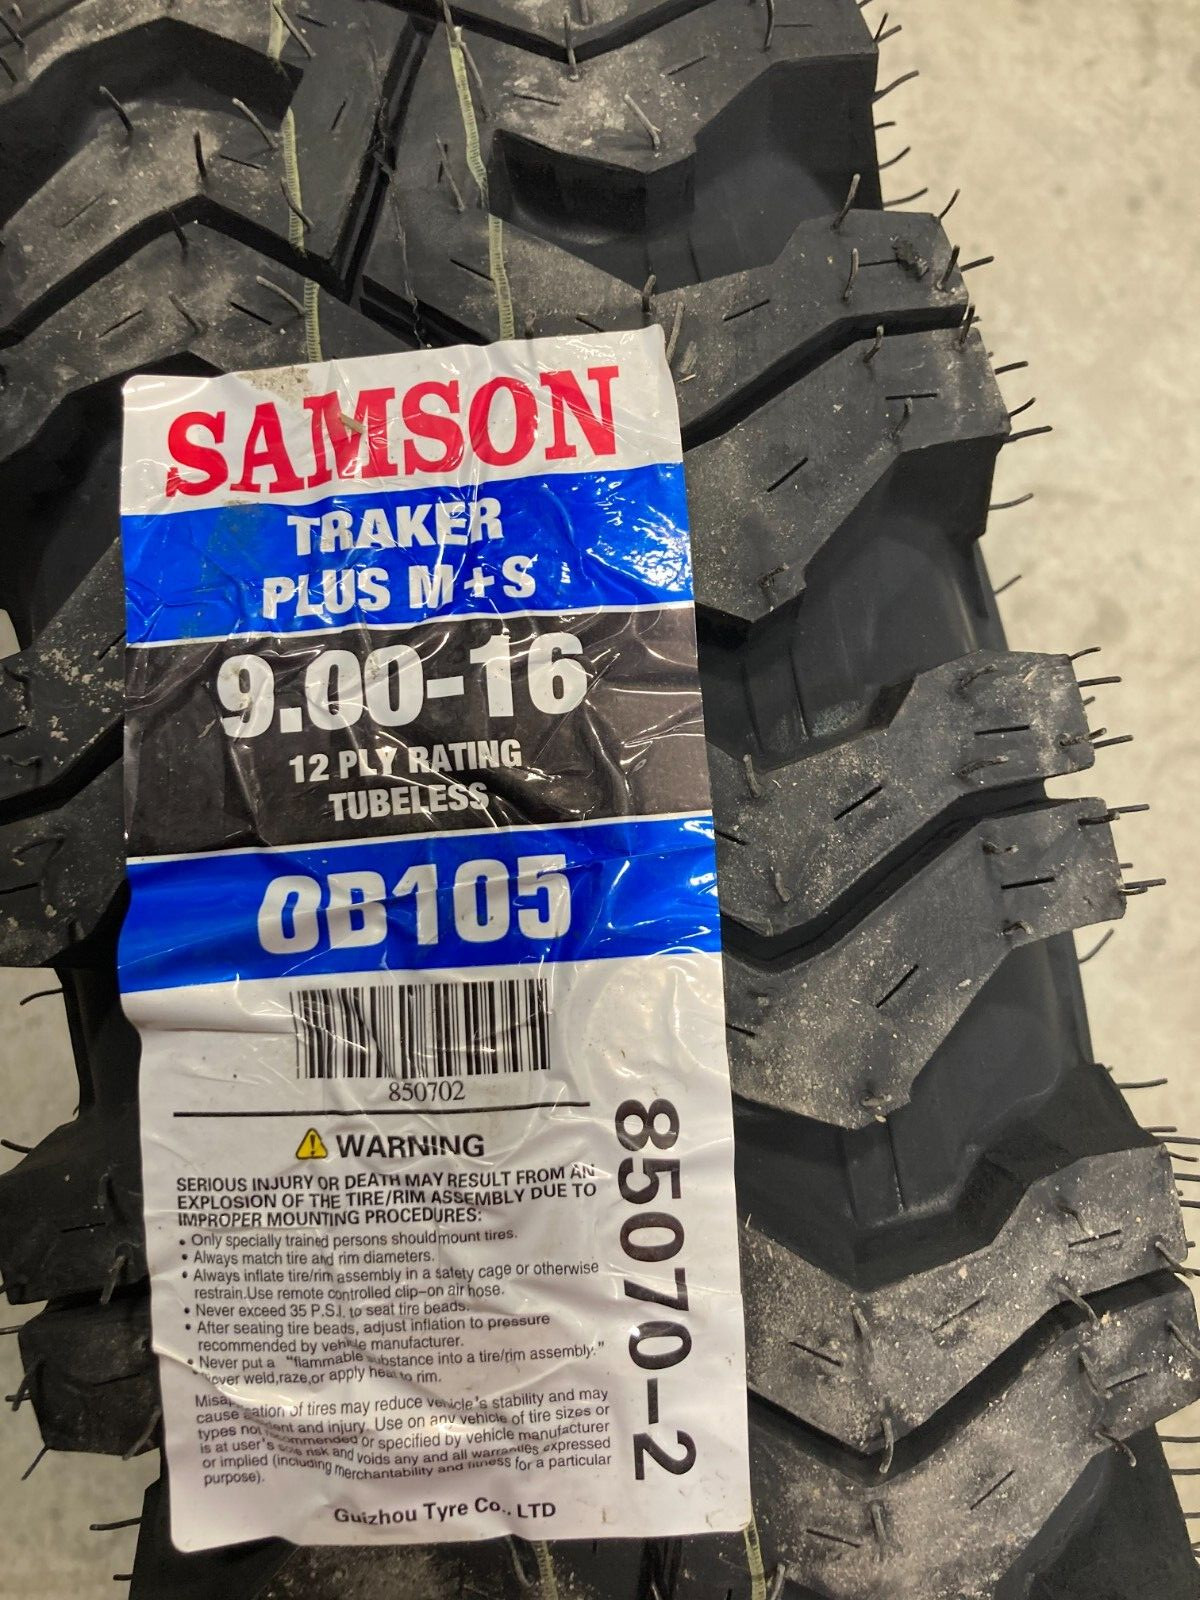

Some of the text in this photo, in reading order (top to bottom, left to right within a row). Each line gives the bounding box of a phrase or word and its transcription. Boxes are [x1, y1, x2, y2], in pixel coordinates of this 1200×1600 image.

[165, 366, 619, 497] SAMSON
[287, 497, 503, 556] TRAKER
[263, 564, 391, 619] PLUS
[217, 631, 588, 739] 9.00-16
[289, 738, 522, 783] 12 PLY RATING
[328, 783, 489, 821] TUBELESS
[389, 1080, 465, 1101] 850702
[336, 1133, 485, 1158] WARNING
[177, 1163, 595, 1192] SERIOUS INJURY OR DEATH MAY RESULT FROM AN
[178, 1182, 597, 1210] EXPLOSION OF THE TIRE/RIM ASSEMBLY DUE TO
[178, 1207, 482, 1227] IMPROPER MOUNTING PROCEDURES:
[191, 1233, 221, 1249] Only
[225, 1234, 281, 1249] specially
[285, 1234, 328, 1248] trained
[333, 1235, 388, 1250] persons
[484, 1229, 518, 1241] tires.
[194, 1250, 435, 1267] Always match tire and rim diameters.
[194, 1260, 599, 1285] Always inflate tire/rim assembly in a safety cage or otherwise
[277, 1287, 324, 1299] remote
[328, 1285, 390, 1301] controlled
[448, 1284, 463, 1296] air
[468, 1284, 504, 1297] hose.
[615, 1098, 697, 1480] 85070-2
[195, 1304, 233, 1317] Never
[238, 1303, 285, 1317] exceed
[290, 1304, 306, 1317] 35
[349, 1306, 362, 1318] to
[366, 1302, 394, 1316] seat
[399, 1301, 420, 1315] tire
[423, 1301, 470, 1315] beads.
[197, 1314, 550, 1337] After seating tire beads, adjust inflation to pressure
[198, 1339, 296, 1352] recommended
[301, 1339, 317, 1355] by
[371, 1335, 464, 1350] manufacturer.
[200, 1356, 238, 1369] Never
[242, 1357, 263, 1371] put
[267, 1359, 275, 1368] a
[438, 1352, 462, 1365] into
[467, 1353, 475, 1363] a
[479, 1345, 525, 1363] tire/rim
[329, 1366, 365, 1382] apply
[417, 1370, 441, 1382] rim.
[308, 1401, 336, 1416] tires
[340, 1400, 370, 1416] may
[375, 1396, 422, 1411] reduce
[492, 1391, 544, 1409] stability
[549, 1389, 574, 1403] and
[580, 1388, 608, 1401] may
[196, 1410, 239, 1424] cause
[298, 1421, 323, 1433] and
[375, 1416, 403, 1431] Use
[408, 1417, 425, 1427] on
[512, 1409, 524, 1425] of
[529, 1408, 550, 1423] tire
[555, 1406, 591, 1419] sizes
[596, 1405, 610, 1416] or
[198, 1426, 237, 1441] types
[362, 1435, 374, 1448] or
[378, 1432, 440, 1452] specified
[466, 1427, 514, 1443] vehicle
[518, 1421, 610, 1441] manufacturer
[200, 1442, 211, 1454] is
[215, 1442, 228, 1452] at
[232, 1437, 274, 1452] user's
[333, 1446, 354, 1461] and
[357, 1452, 390, 1465] voids
[395, 1454, 418, 1466] any
[423, 1452, 447, 1464] and
[452, 1450, 467, 1461] all
[543, 1436, 611, 1453] expressed
[202, 1458, 215, 1469] or
[220, 1454, 268, 1469] implied
[334, 1462, 434, 1480] merchantability
[438, 1462, 463, 1474] and
[515, 1455, 531, 1471] for
[536, 1459, 544, 1468] a
[549, 1453, 612, 1470] particular
[204, 1471, 265, 1487] purpose).
[334, 1507, 417, 1525] Guizhou
[423, 1501, 468, 1522] Tyre
[517, 1502, 556, 1518] LTD
